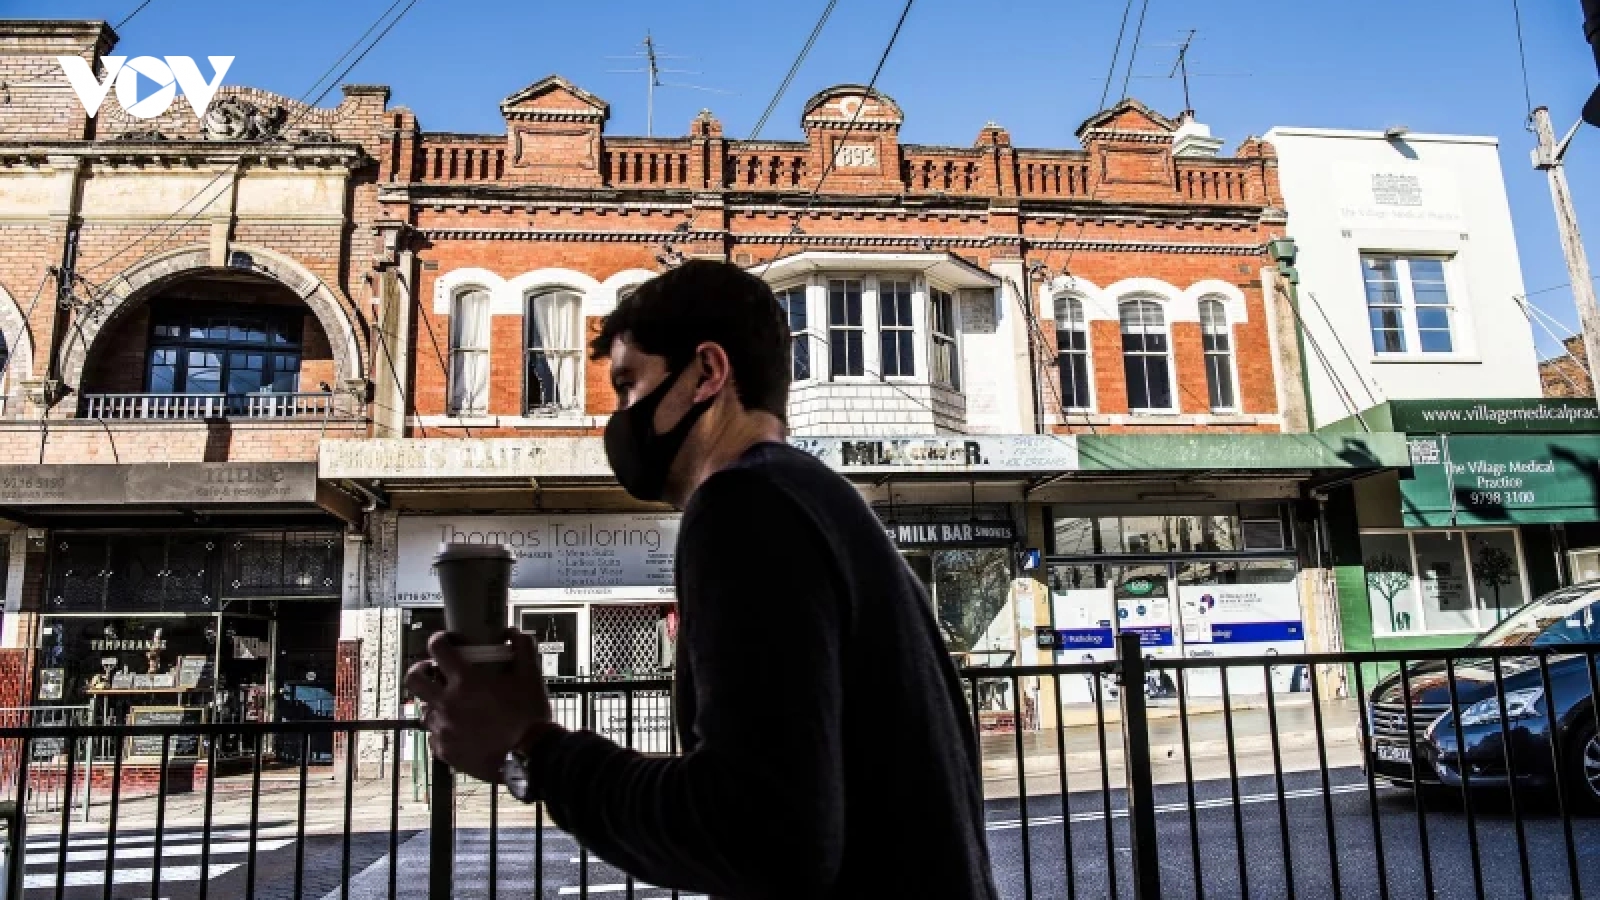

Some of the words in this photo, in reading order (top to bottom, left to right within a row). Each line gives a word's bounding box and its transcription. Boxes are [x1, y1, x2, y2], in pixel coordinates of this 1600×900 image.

[1467, 460, 1507, 477] Village
[1509, 460, 1555, 474] Medical
[1477, 475, 1523, 489] Practice
[435, 523, 541, 547] Thomas
[552, 523, 662, 552] Tailoring
[898, 525, 938, 543] MILK
[942, 524, 973, 541] BAR
[90, 639, 167, 651] TEMPERANE
